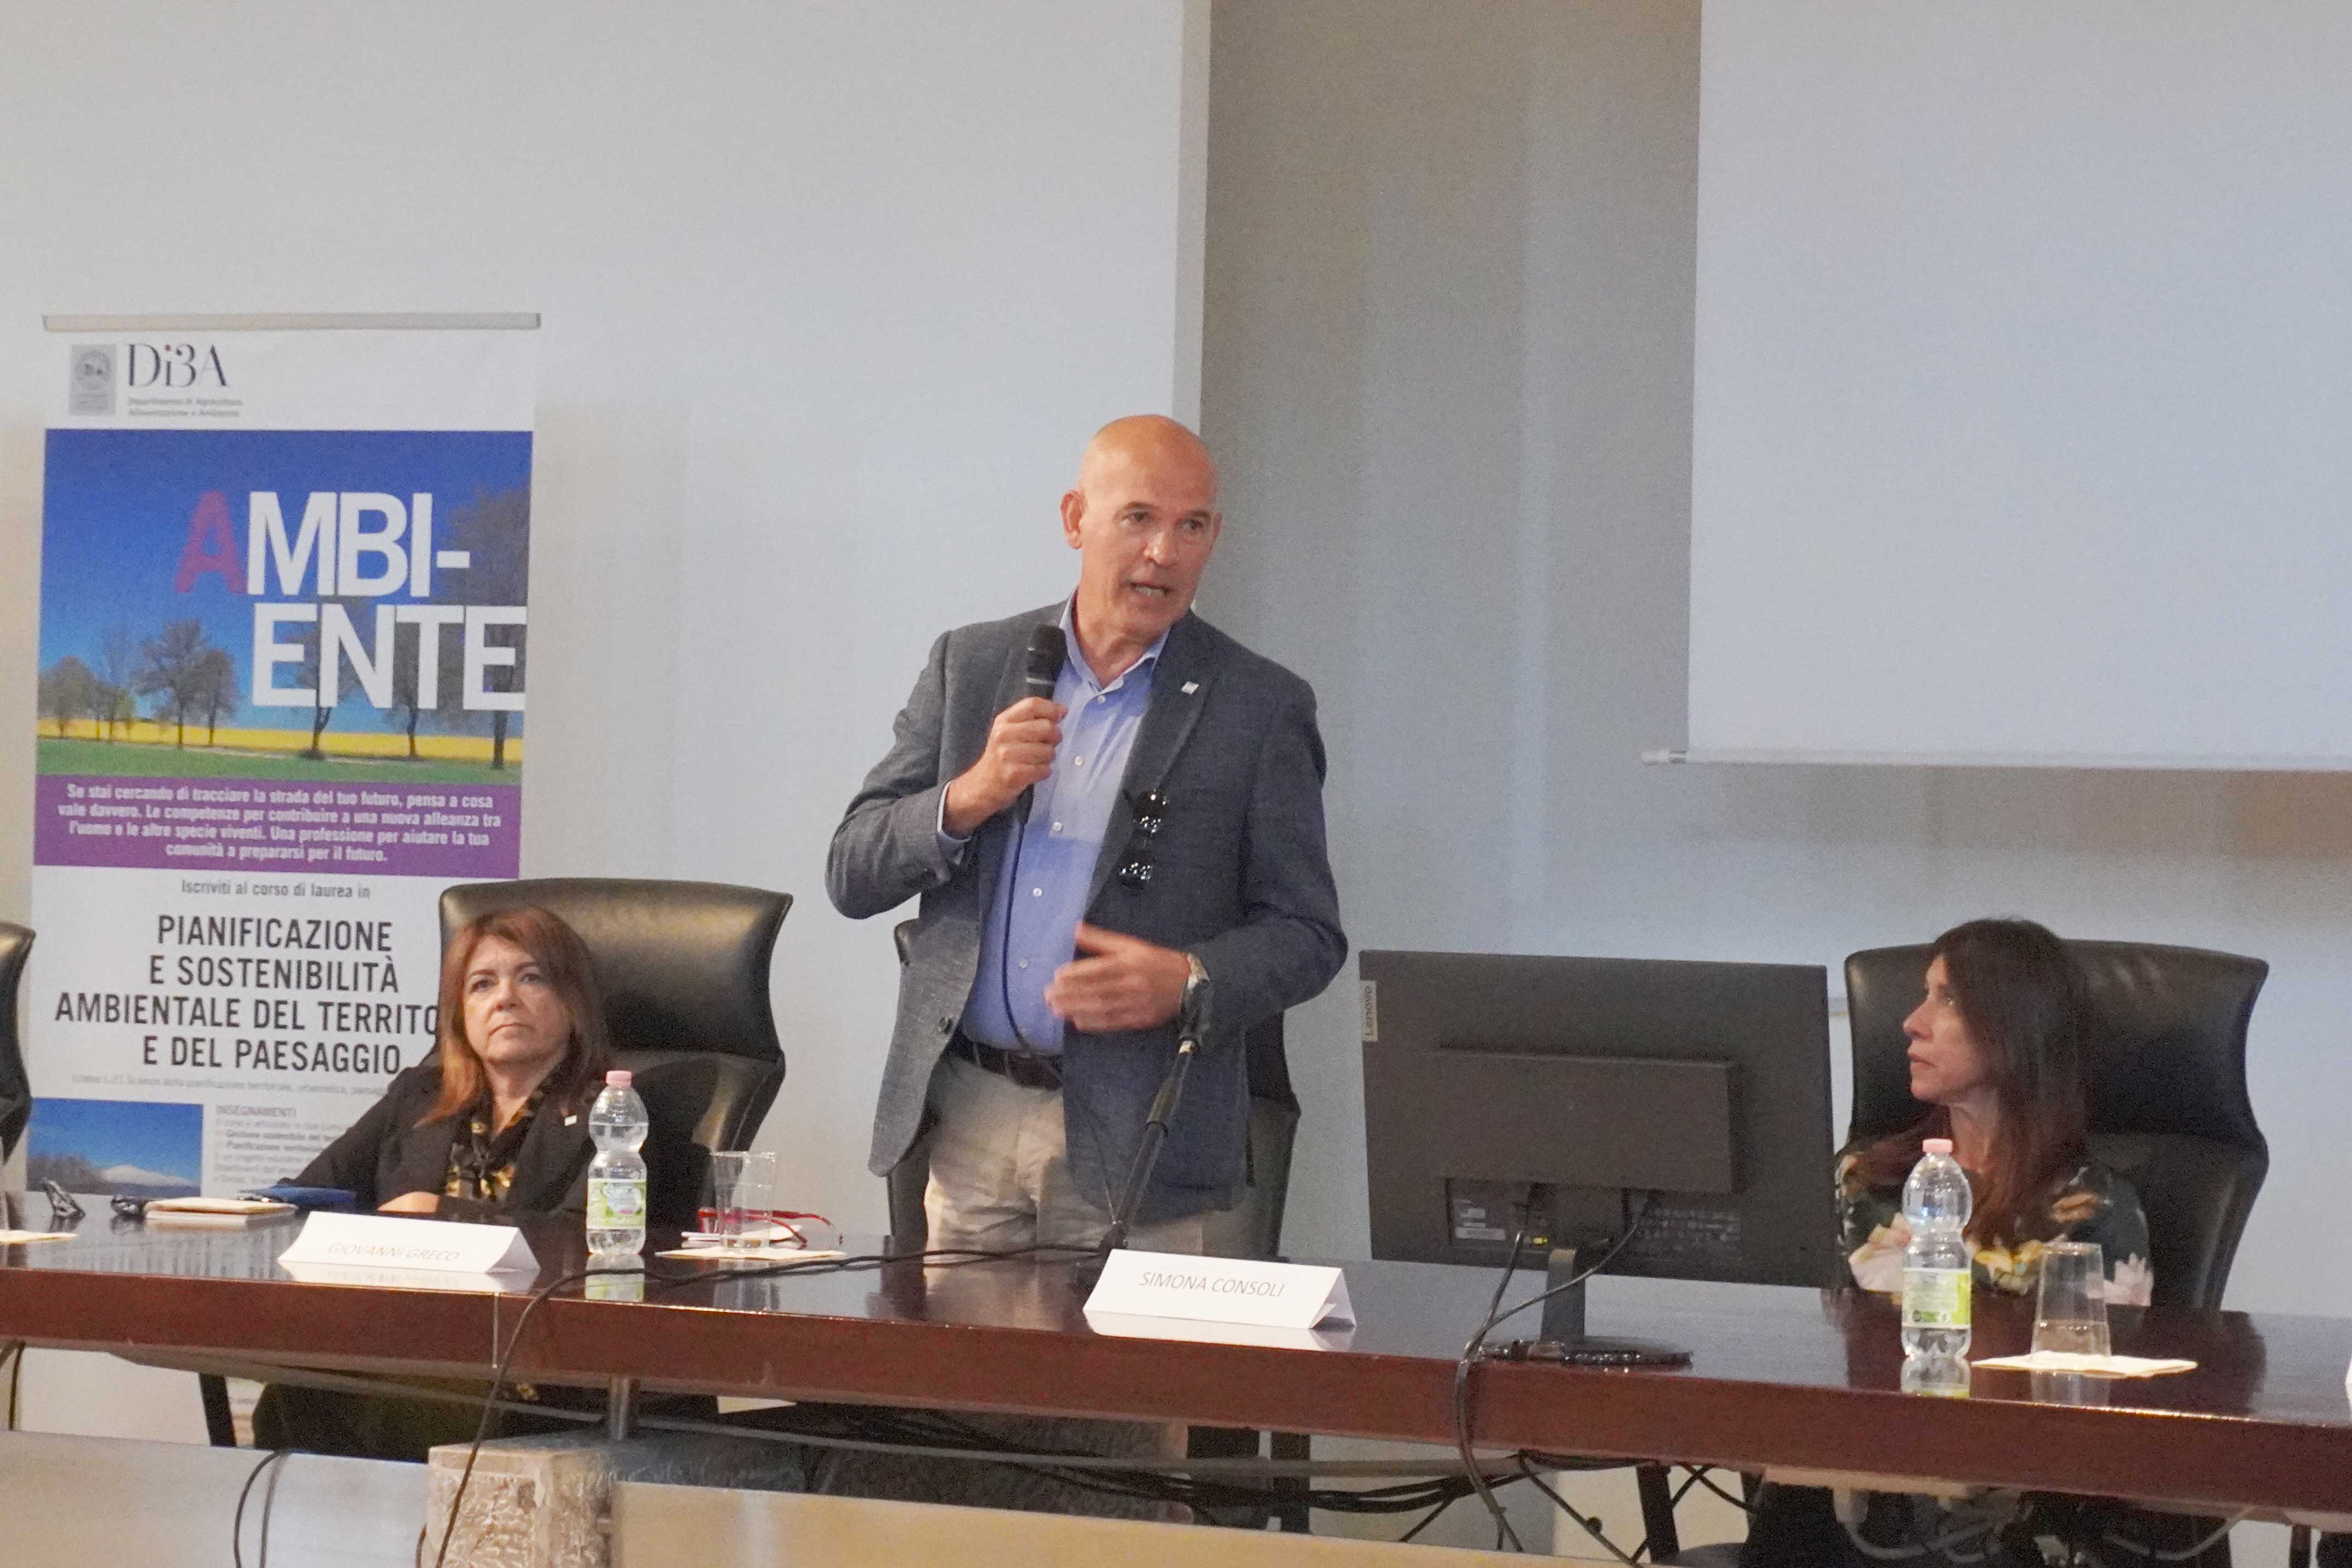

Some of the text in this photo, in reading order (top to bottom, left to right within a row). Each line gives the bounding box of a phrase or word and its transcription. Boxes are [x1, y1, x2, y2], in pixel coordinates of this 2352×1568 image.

[175, 490, 470, 597] AMBI-
[252, 603, 527, 711] ENTE
[67, 784, 493, 809] Se stai cercando di tracciare la strada del tuo futuro, pensa a cosa
[58, 803, 501, 827] vale davvero. Le competenze per contribuire a una nuova alleanza tra
[70, 821, 489, 846] l'uomo e le altre specie viventi. Una professione per aiutare la tua
[166, 842, 388, 862] comunità a prepararsi per il futuro.
[182, 879, 370, 898] Iscriviti al corso di laurea in
[158, 915, 392, 951] PIANIFICAZIONE
[150, 954, 398, 993] E SOSTENIBILITÀ
[55, 992, 240, 1028] AMBIENTALE
[254, 999, 305, 1030] DEL
[143, 1035, 401, 1074] E DEL PAESAGGIO
[328, 1242, 460, 1261] GIOVANNI GRECO
[1140, 1271, 1285, 1297] SIMONA CONSOLI
